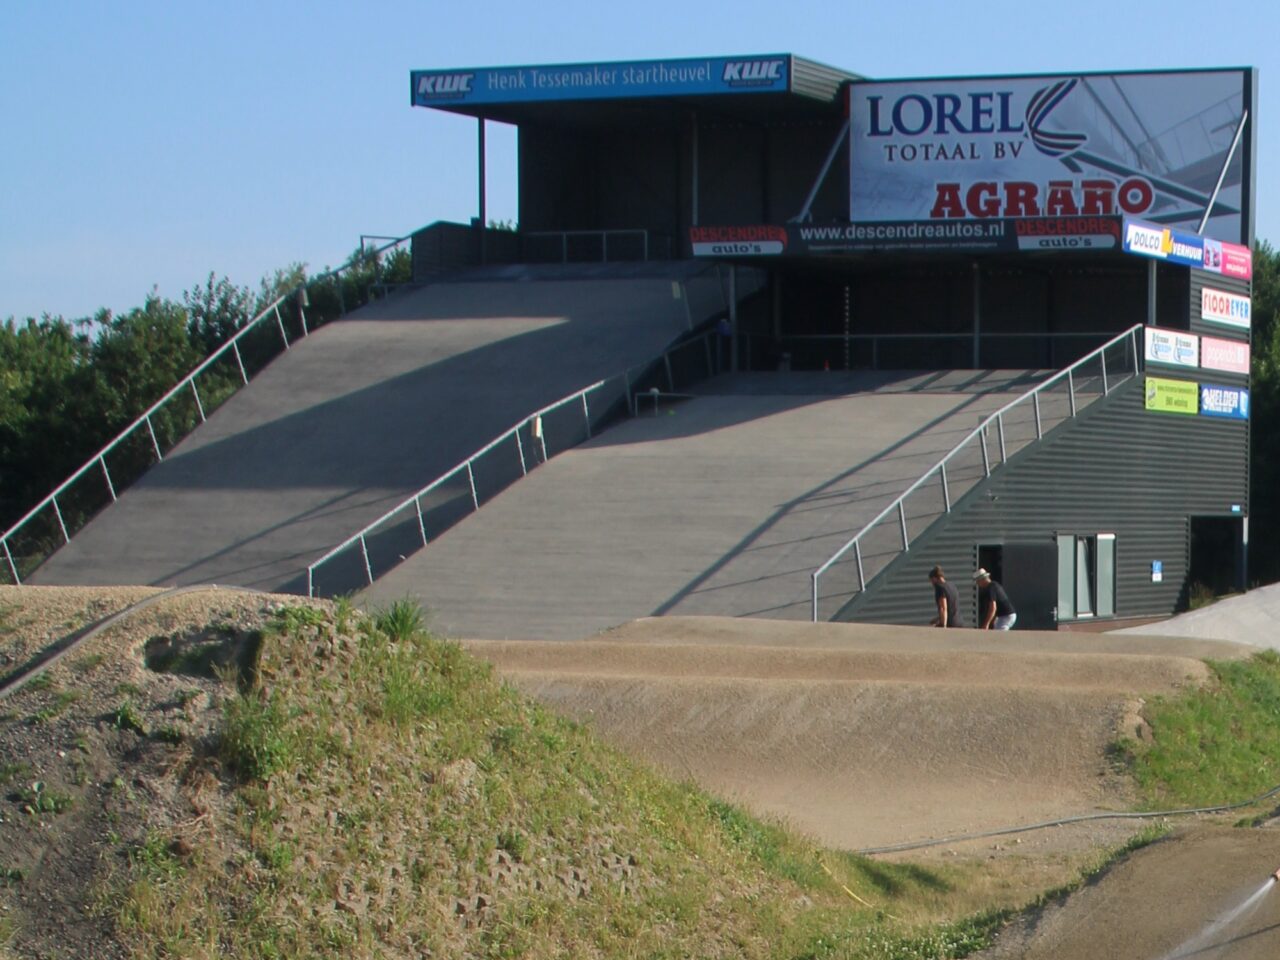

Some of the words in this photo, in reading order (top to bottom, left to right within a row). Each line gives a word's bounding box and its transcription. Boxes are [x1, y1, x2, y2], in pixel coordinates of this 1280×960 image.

[488, 71, 526, 90] Henk
[531, 66, 617, 88] Tessemaker
[622, 61, 711, 85] startheuvel
[723, 60, 784, 80] KWC
[418, 74, 474, 94] KWC
[866, 91, 1025, 137] LOREL
[884, 142, 981, 162] TOTAAL
[994, 141, 1024, 160] BV
[930, 178, 1153, 218] AGRARO
[690, 225, 779, 241] DESCENDRE
[800, 219, 1004, 241] www.descendreautos.nl
[1016, 217, 1106, 235] DESCENDRE
[712, 243, 762, 255] auto's
[1039, 237, 1092, 248] auto's
[1134, 231, 1160, 250] DOLCO
